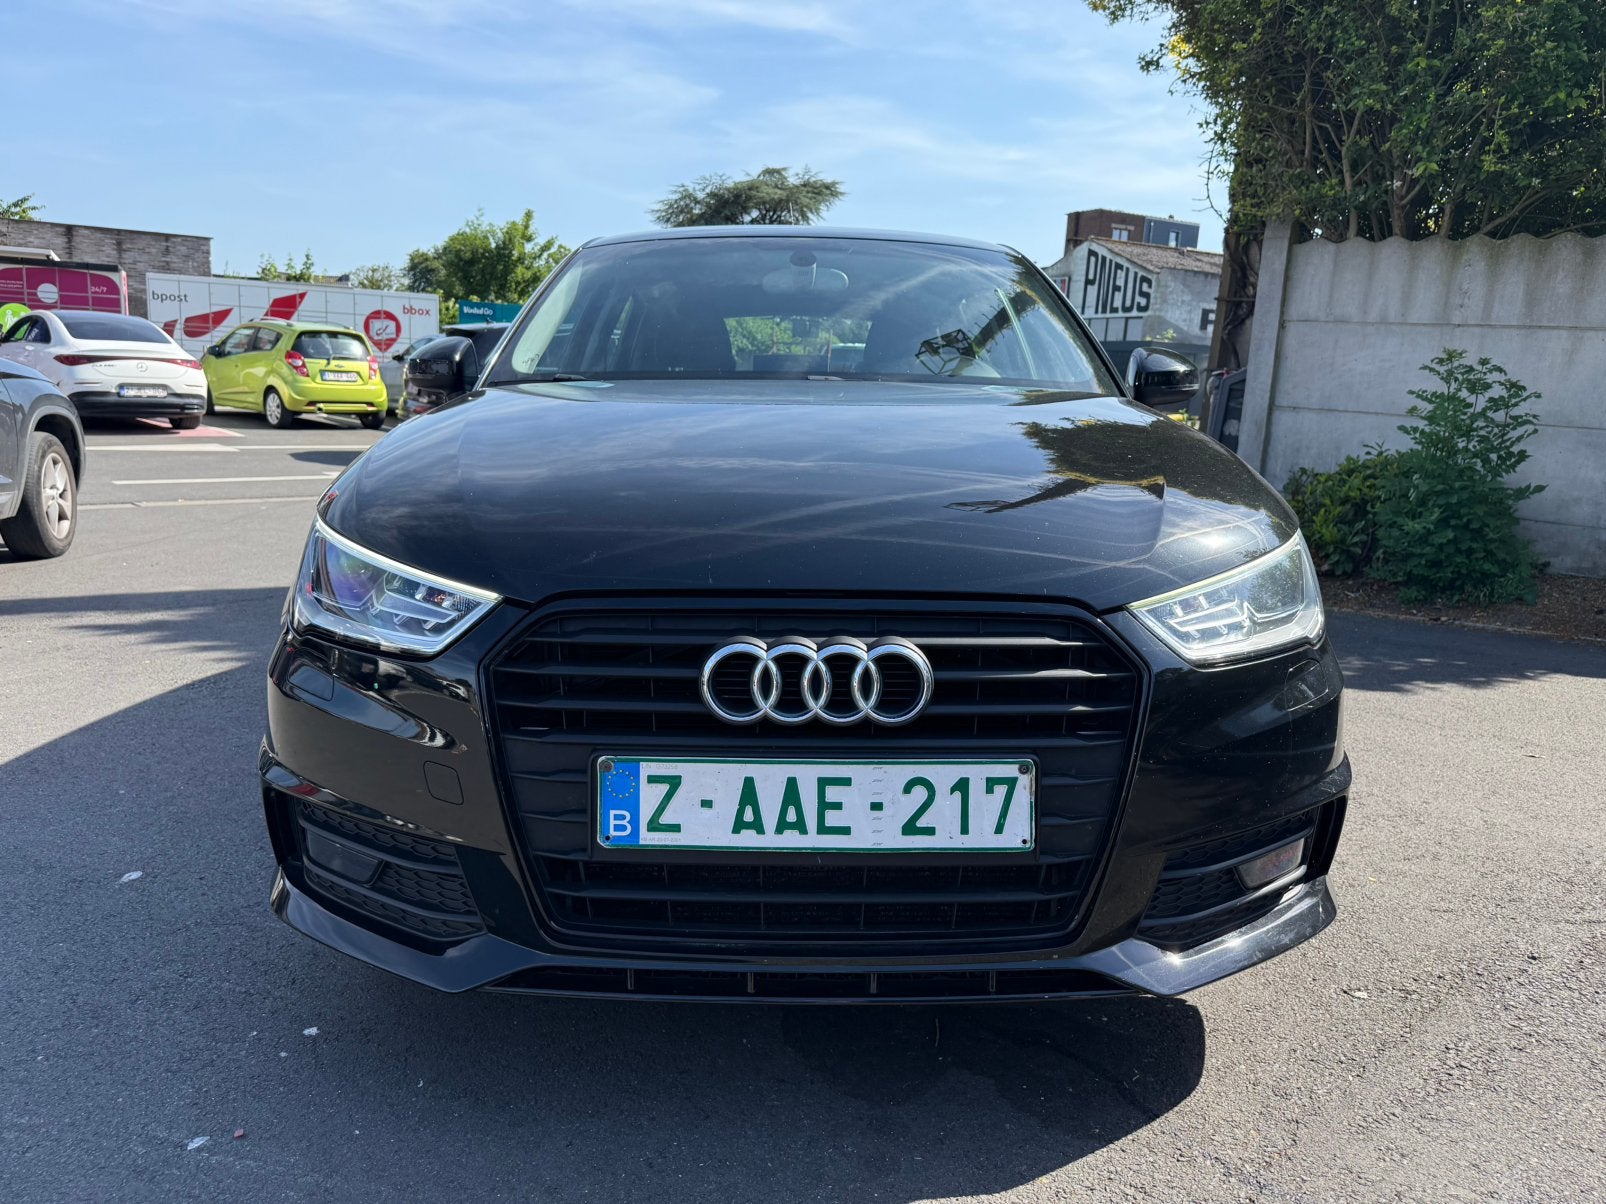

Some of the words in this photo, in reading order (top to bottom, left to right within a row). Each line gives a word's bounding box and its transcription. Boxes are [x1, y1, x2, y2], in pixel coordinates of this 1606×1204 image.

[1081, 247, 1152, 315] PNEUS
[151, 290, 189, 303] bpost
[402, 304, 431, 316] bbox
[646, 774, 1019, 836] Z-AAE-217
[609, 809, 632, 837] B
